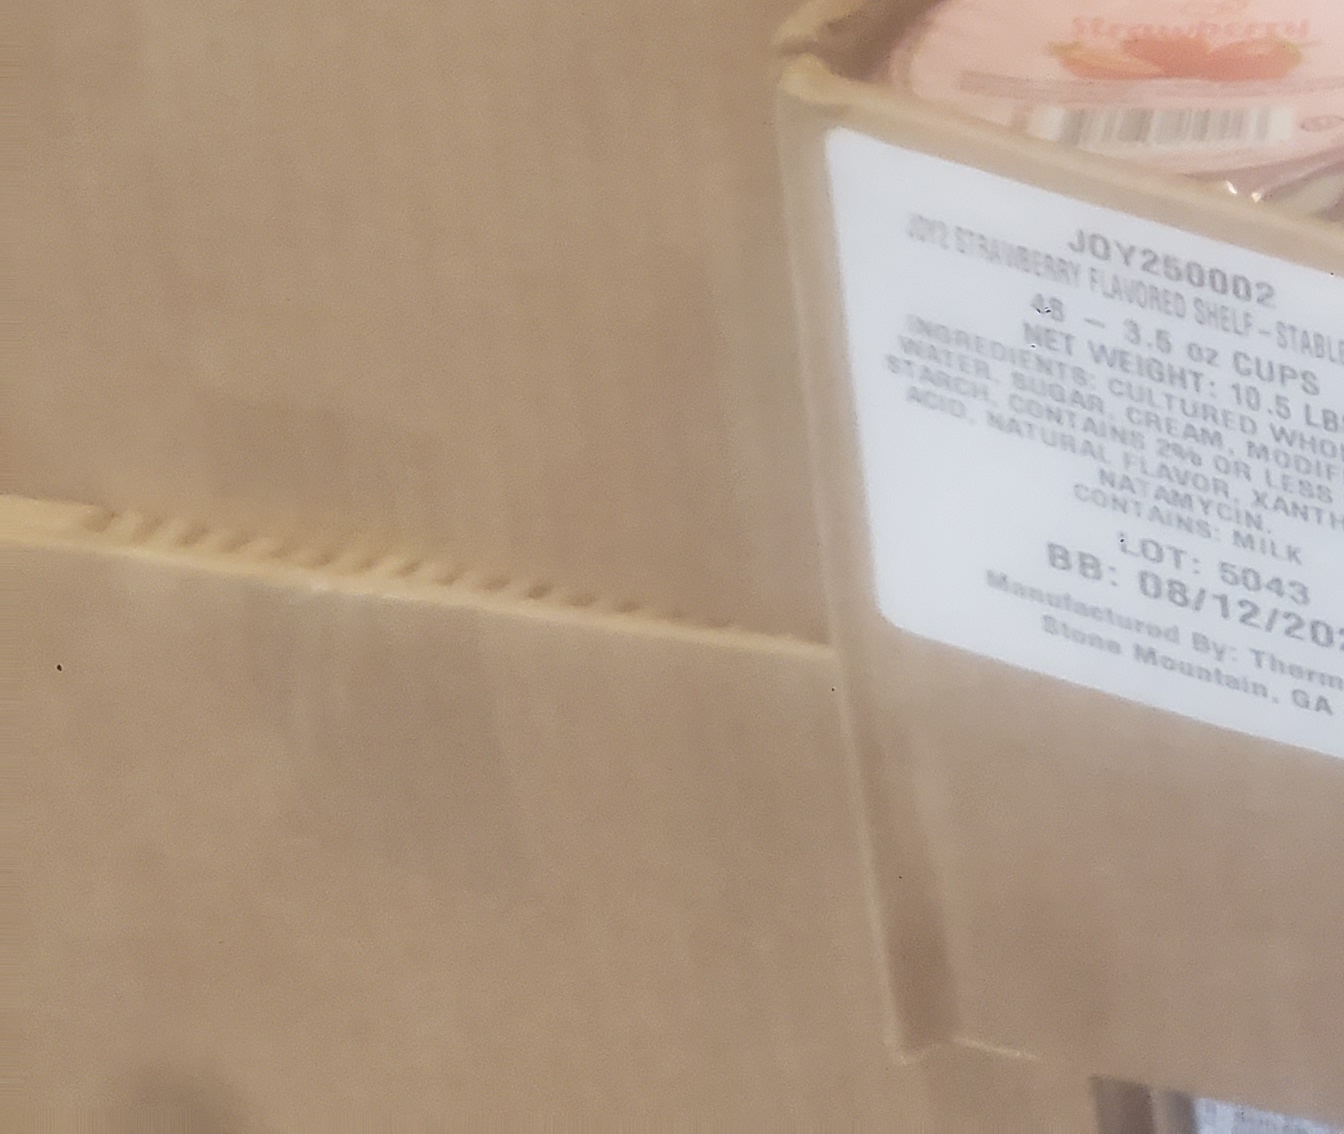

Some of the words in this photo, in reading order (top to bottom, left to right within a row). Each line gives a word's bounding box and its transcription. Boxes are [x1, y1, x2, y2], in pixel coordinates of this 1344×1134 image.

[1067, 228, 1277, 310] JOY250002
[1089, 266, 1187, 320] FLAVORED
[1022, 320, 1076, 356] NET
[1087, 338, 1218, 398] WEIGHT:
[1231, 382, 1292, 421] 10.5
[1122, 317, 1172, 355] 3.5
[1186, 341, 1219, 367] oz
[1233, 350, 1321, 398] CUPS
[986, 408, 1111, 464] NATURAL
[1107, 377, 1258, 436] CULTURED
[1125, 406, 1235, 456] CREAM,
[1008, 393, 1145, 451] CONTAINS
[1213, 454, 1251, 483] OR
[1265, 468, 1333, 505] LESS
[1073, 483, 1222, 543] CONTAINS:
[1232, 529, 1302, 566] MILK
[1099, 467, 1272, 535] NATAMYCIN.
[1047, 541, 1119, 588] BB:
[1117, 530, 1202, 575] LOT:
[1218, 559, 1312, 608] 5043
[985, 569, 1180, 644] Manufactured
[1042, 613, 1122, 655] Stone
[1133, 642, 1280, 704] Mountain,
[1291, 688, 1334, 716] GA
